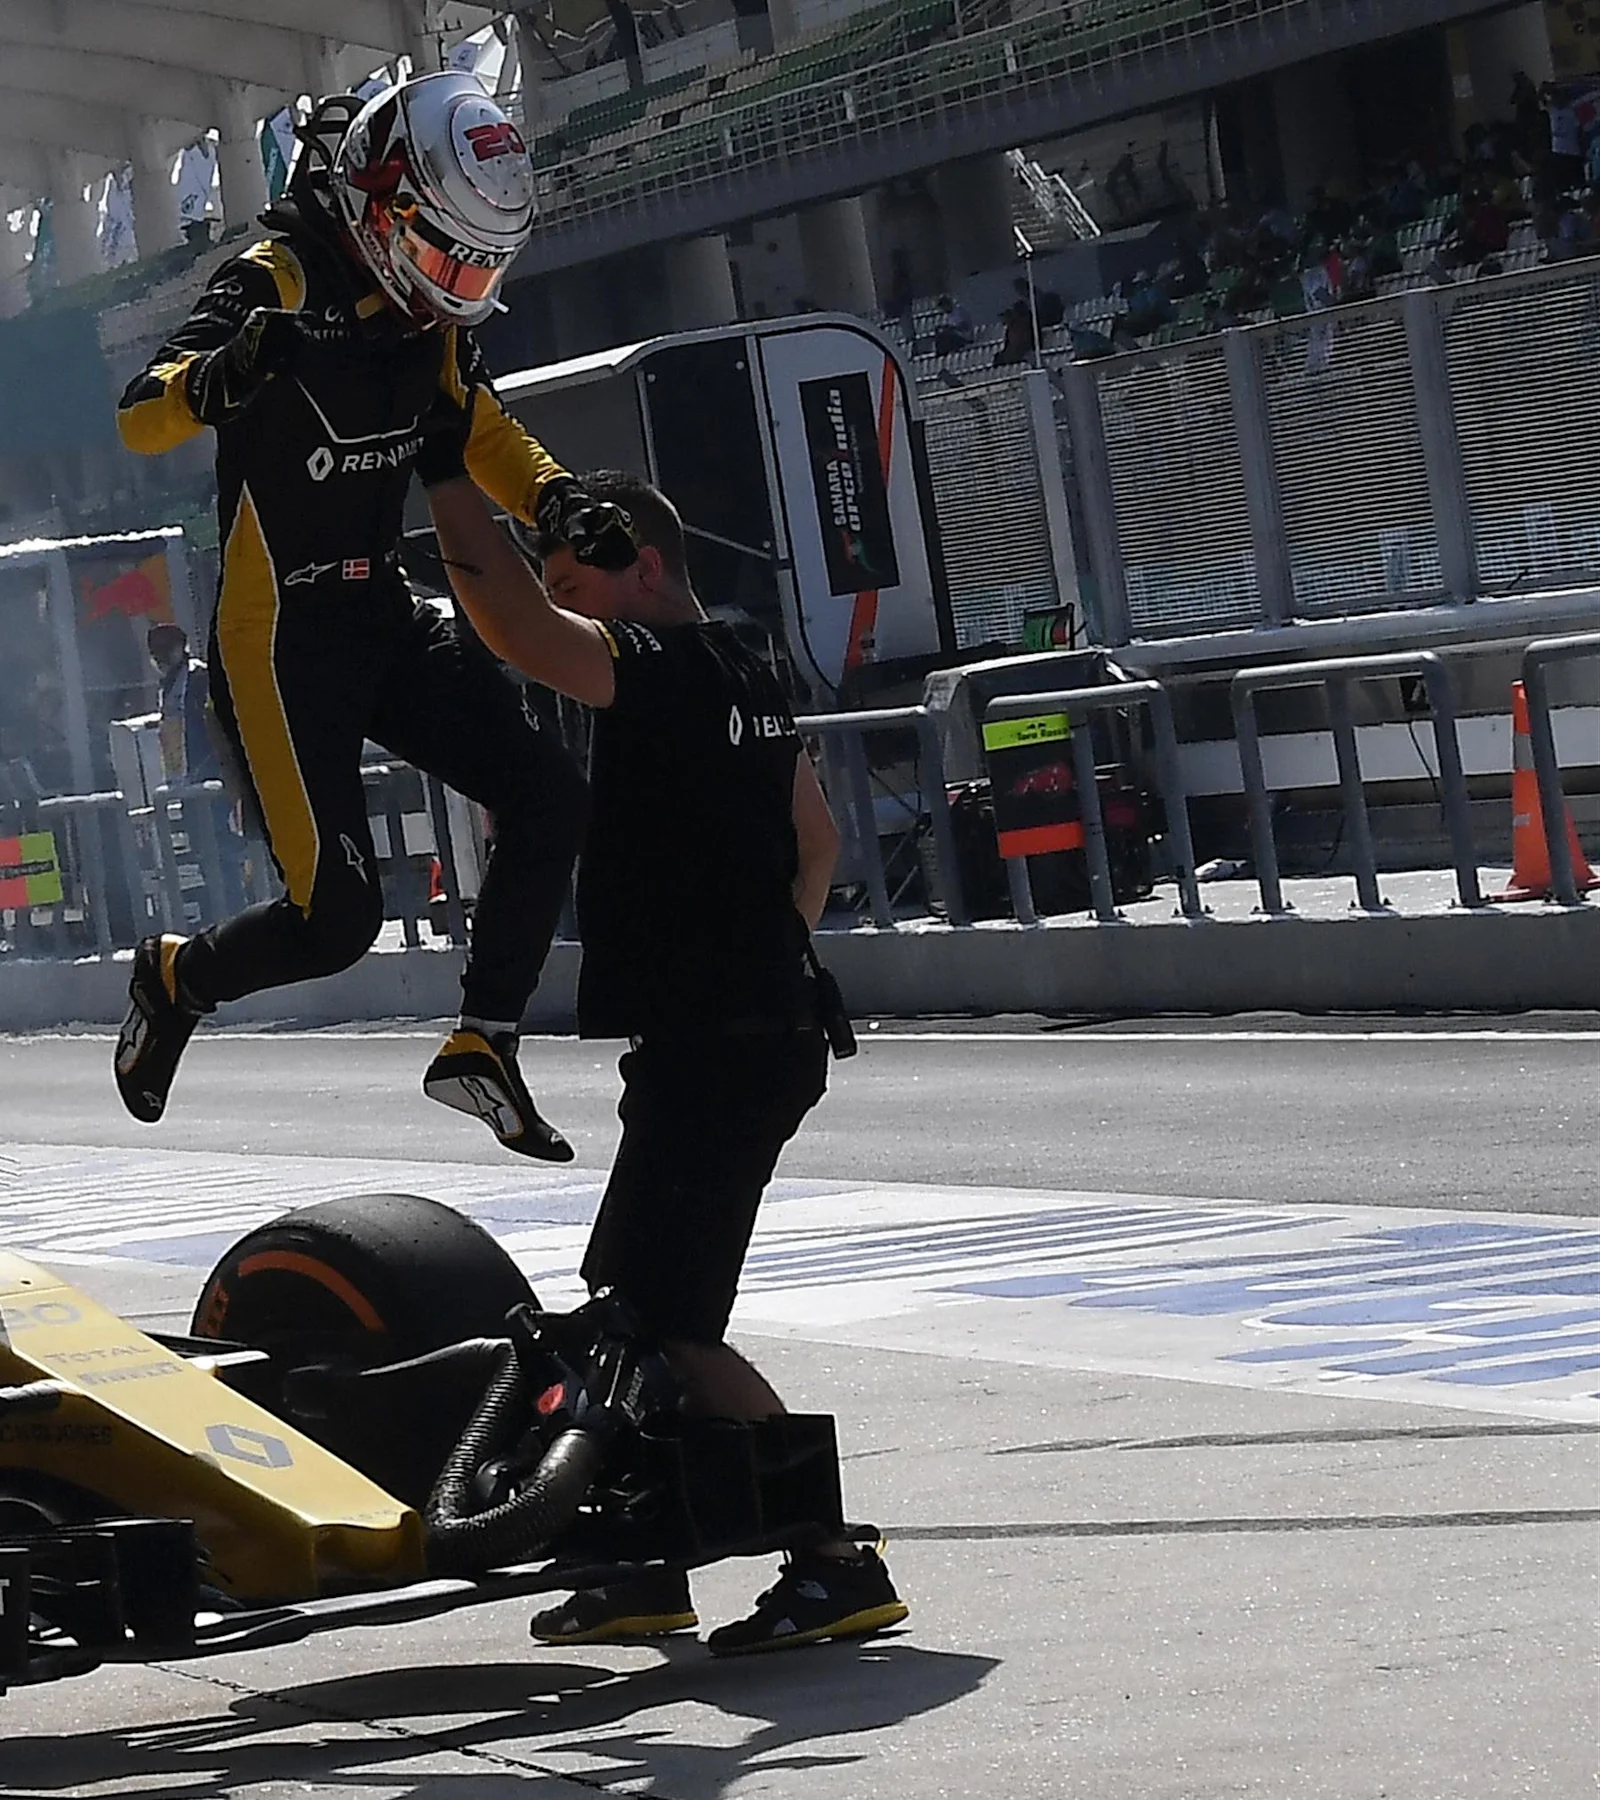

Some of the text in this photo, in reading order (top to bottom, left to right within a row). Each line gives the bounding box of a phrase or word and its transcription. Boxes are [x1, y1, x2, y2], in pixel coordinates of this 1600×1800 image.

[463, 122, 526, 162] 20
[341, 436, 425, 473] RENAULT
[826, 459, 847, 527] SAHARA
